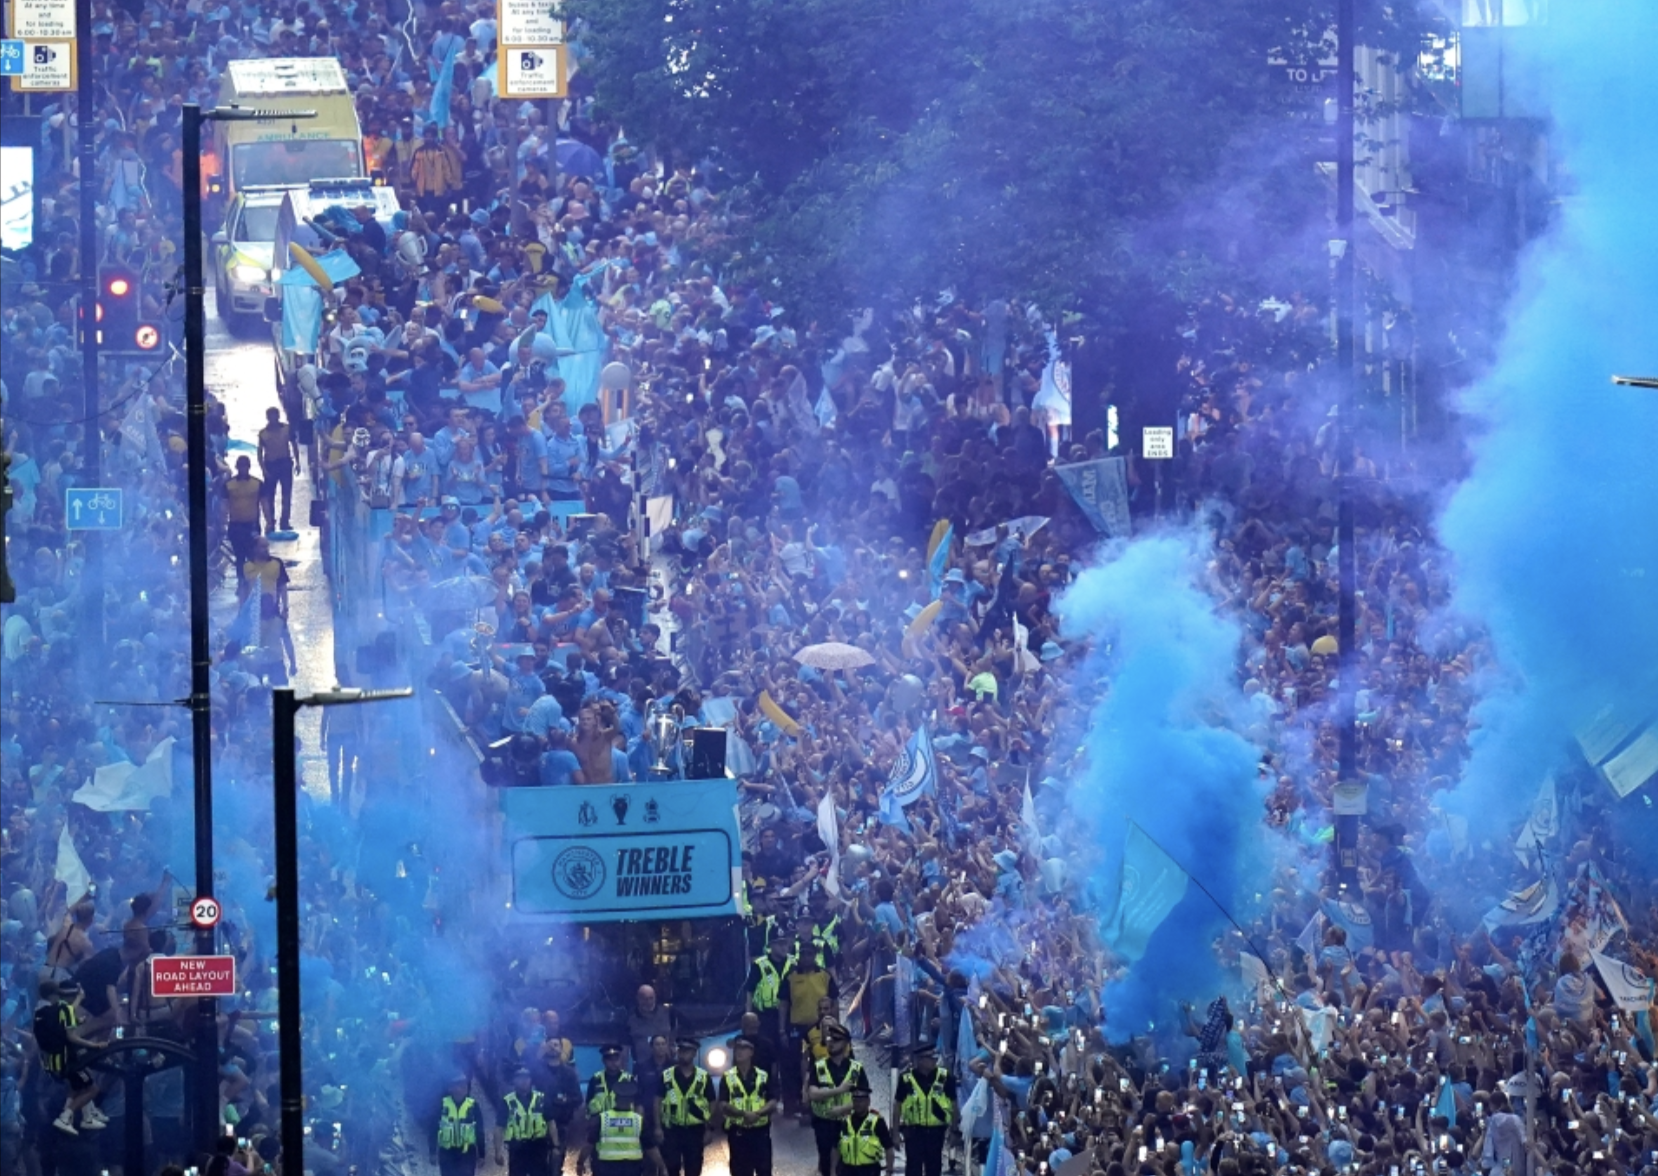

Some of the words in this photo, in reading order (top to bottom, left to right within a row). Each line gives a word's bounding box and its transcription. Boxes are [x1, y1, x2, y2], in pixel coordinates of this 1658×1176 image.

[1286, 68, 1307, 82] TO
[257, 131, 330, 142] AMBULANCE
[1144, 429, 1172, 437] Loading
[616, 845, 695, 876] TREBLE
[616, 873, 693, 897] WINNERS
[196, 905, 217, 918] 20
[180, 961, 206, 970] NEW
[156, 971, 187, 982] ROAD
[189, 970, 230, 981] LAYOUT
[173, 982, 212, 992] AHEAD
